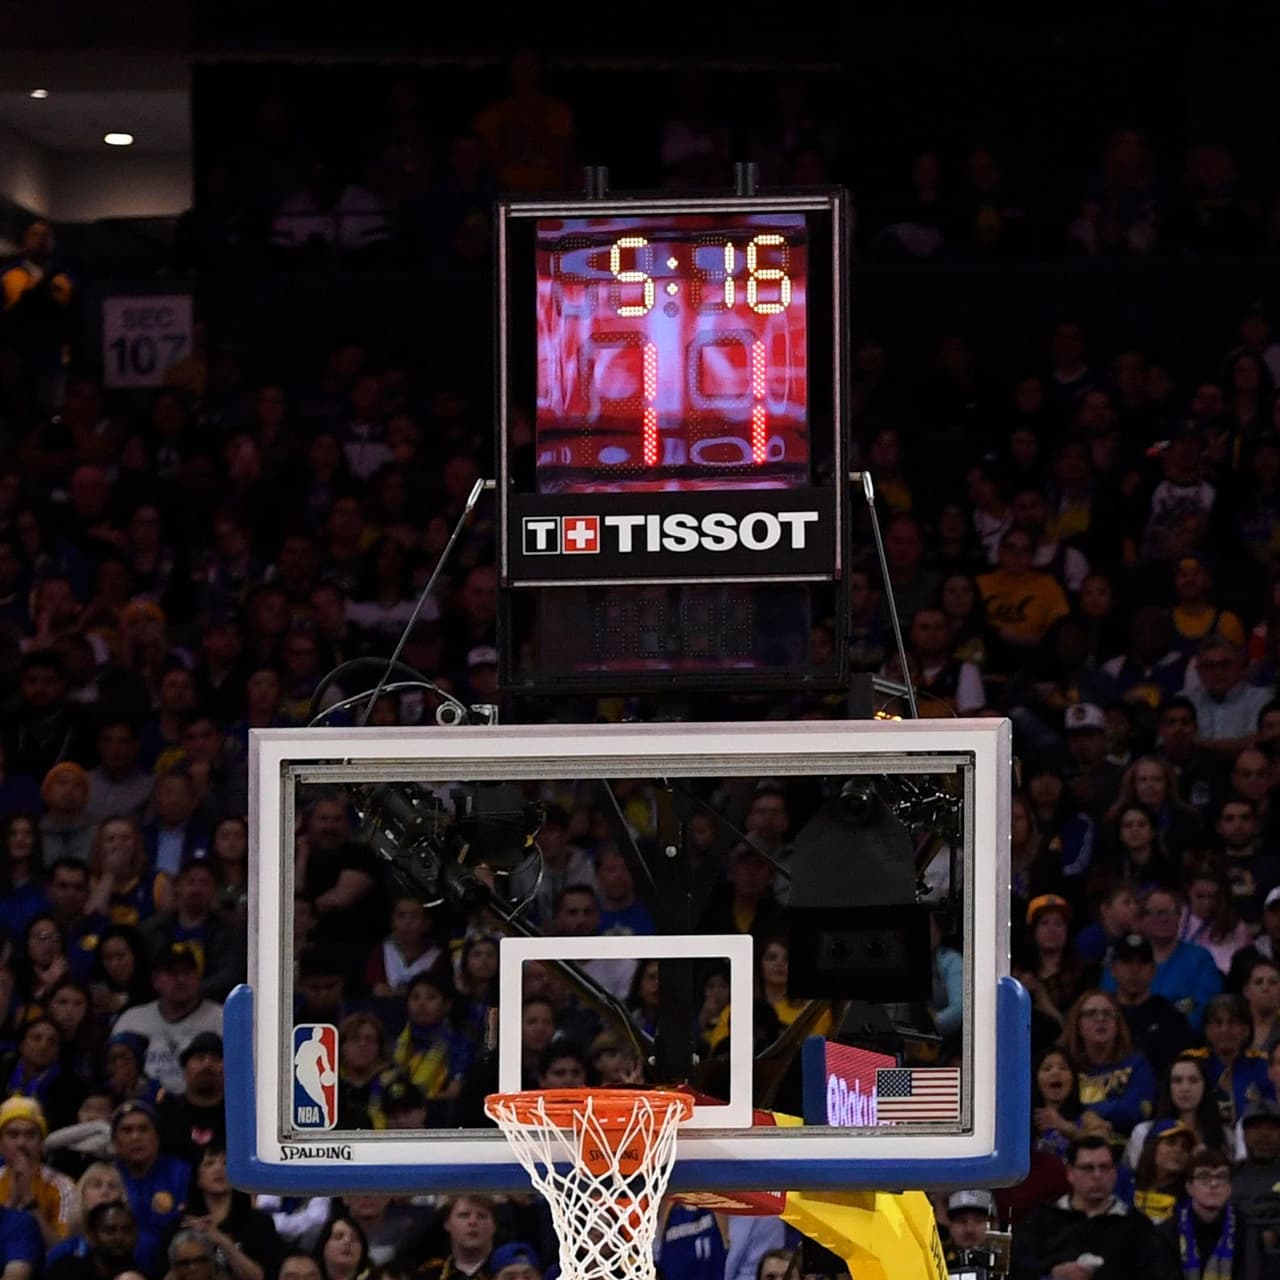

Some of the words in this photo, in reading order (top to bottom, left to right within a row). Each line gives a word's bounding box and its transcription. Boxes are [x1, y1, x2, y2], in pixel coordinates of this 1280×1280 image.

[609, 234, 792, 318] 5:16
[604, 510, 820, 553] TISSOT
[297, 1106, 321, 1125] NBA
[280, 1144, 352, 1162] SPALDING
